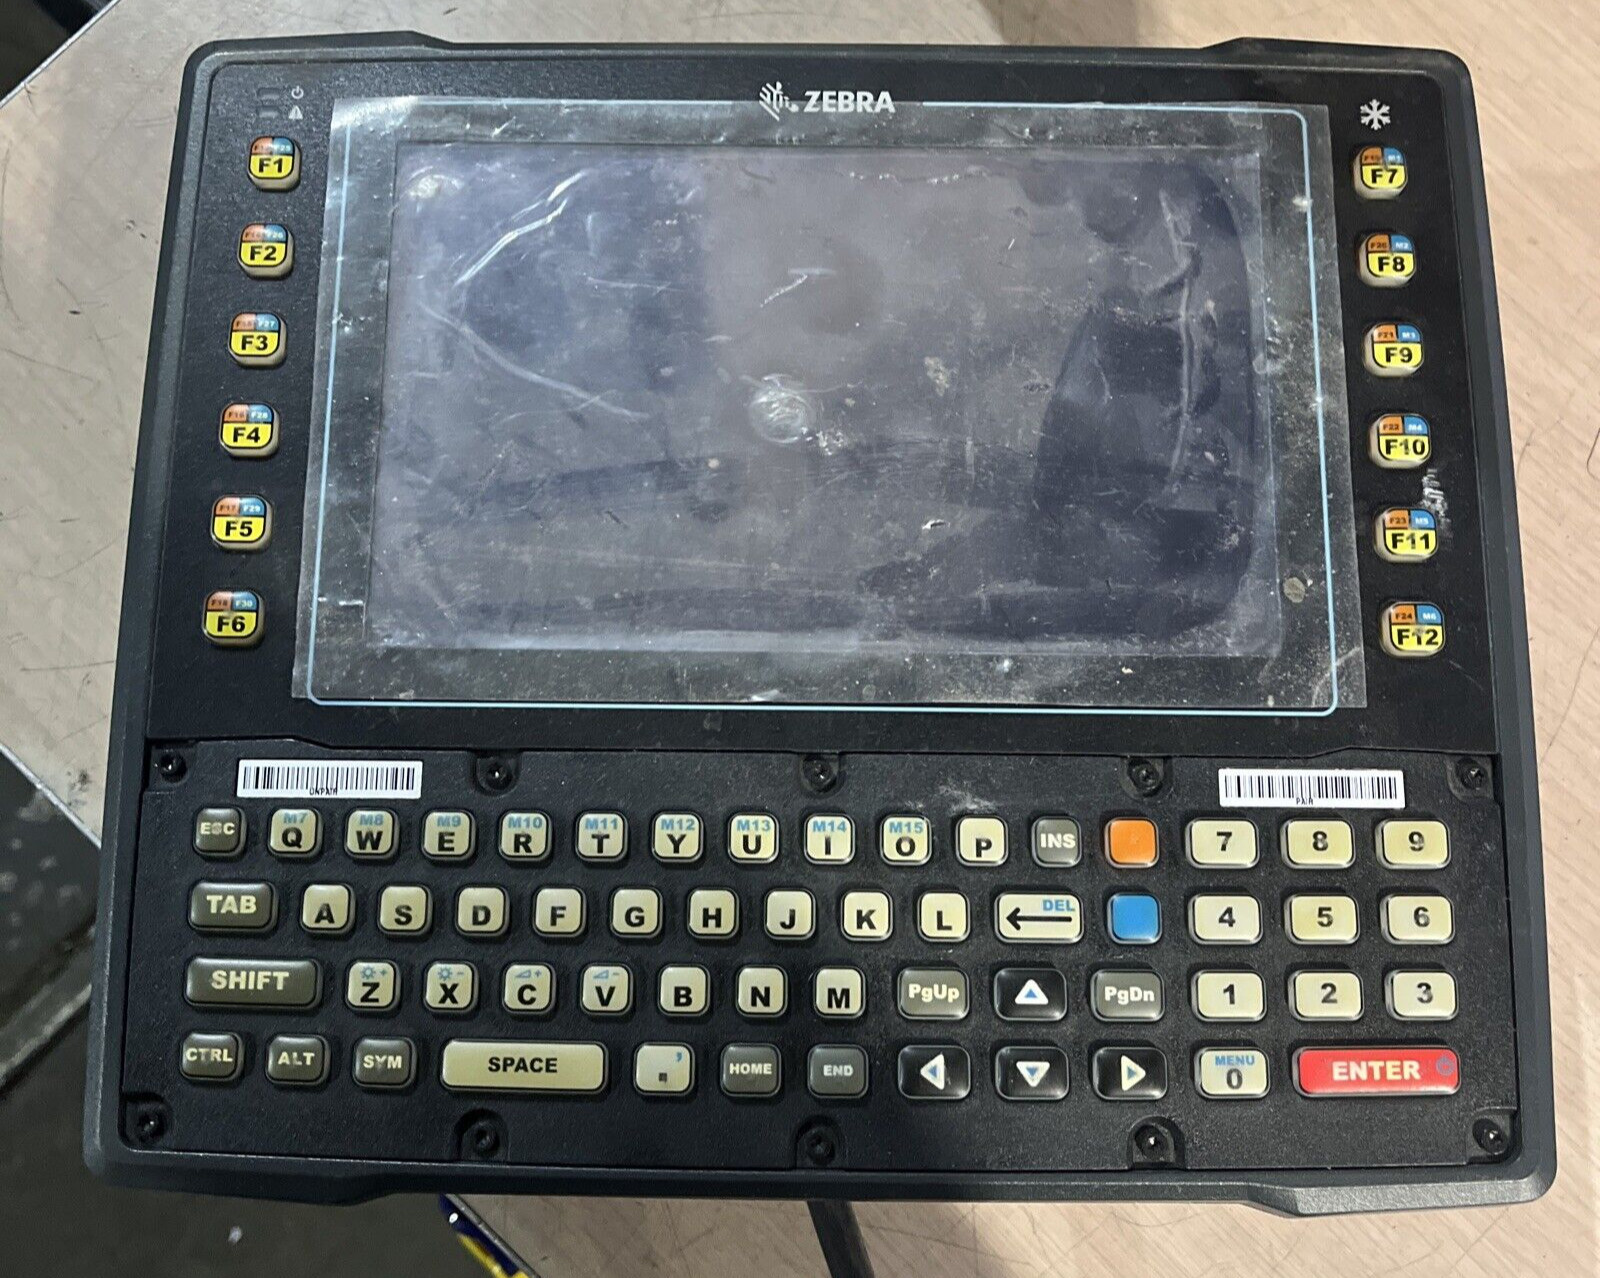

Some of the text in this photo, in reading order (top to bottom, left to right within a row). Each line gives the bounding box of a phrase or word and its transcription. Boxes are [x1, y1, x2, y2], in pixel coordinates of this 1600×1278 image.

[804, 91, 896, 113] ZEBRA
[258, 158, 283, 173] F1
[1371, 168, 1398, 184] F7
[250, 245, 277, 261] F2
[1378, 257, 1405, 272] F8
[258, 319, 275, 327] F27
[241, 335, 269, 350] F3
[1385, 347, 1413, 363] F9
[232, 427, 260, 443] F4
[1385, 439, 1426, 456] F10
[225, 520, 253, 537] F5
[1389, 516, 1406, 524] F23
[1391, 532, 1430, 549] F11
[217, 615, 246, 632] F6
[1397, 629, 1439, 646] F12
[309, 788, 338, 796] UNPAIR
[1296, 797, 1314, 805] PAIR
[283, 812, 308, 824] M7
[359, 814, 384, 826] M8
[436, 815, 461, 827] M9
[508, 817, 543, 829] M10
[585, 818, 618, 830] M11
[660, 819, 696, 831] M12
[737, 820, 771, 832] M13
[812, 821, 847, 833] M14
[889, 822, 924, 833] M15
[200, 821, 236, 835] ESC
[282, 828, 302, 848] Q
[356, 830, 383, 850] W
[438, 832, 455, 851] E
[513, 833, 533, 853] R
[591, 834, 610, 854] T
[667, 834, 687, 854] Y
[742, 835, 762, 854] U
[824, 836, 831, 855] I
[895, 836, 916, 857] O
[1040, 833, 1076, 849] INS
[1216, 831, 1233, 852] 7
[1312, 831, 1329, 852] 8
[1408, 831, 1425, 852] 9
[975, 838, 993, 858] P
[206, 895, 257, 914] TAB
[314, 903, 336, 924] A
[1042, 899, 1075, 912] DEL
[394, 904, 413, 925] S
[472, 906, 492, 926] D
[550, 906, 567, 926] F
[625, 907, 645, 928] G
[702, 907, 722, 928] H
[779, 909, 796, 930] J
[856, 909, 877, 930] K
[936, 911, 953, 931] L
[1218, 907, 1236, 928] 4
[1317, 907, 1334, 928] 5
[1413, 907, 1431, 928] 6
[210, 970, 290, 991] SHIFT
[360, 982, 380, 1003] Z
[438, 983, 459, 1004] X
[517, 984, 537, 1006] C
[595, 986, 616, 1007] V
[674, 986, 693, 1007] B
[751, 986, 771, 1007] N
[827, 987, 851, 1009] M
[908, 984, 960, 1002] PgUp
[1105, 986, 1155, 1005] PgDn
[1223, 984, 1236, 1005] 1
[1321, 983, 1338, 1004] 2
[1416, 983, 1434, 1004] 3
[185, 1048, 233, 1063] CTRL
[278, 1052, 315, 1066] ALT
[363, 1055, 403, 1069] SYM
[487, 1057, 558, 1073] SPACE
[1215, 1055, 1255, 1066] MENU
[729, 1062, 773, 1075] HOME
[823, 1064, 854, 1077] END
[1332, 1061, 1421, 1081] ENTER
[1226, 1068, 1243, 1090] 0
